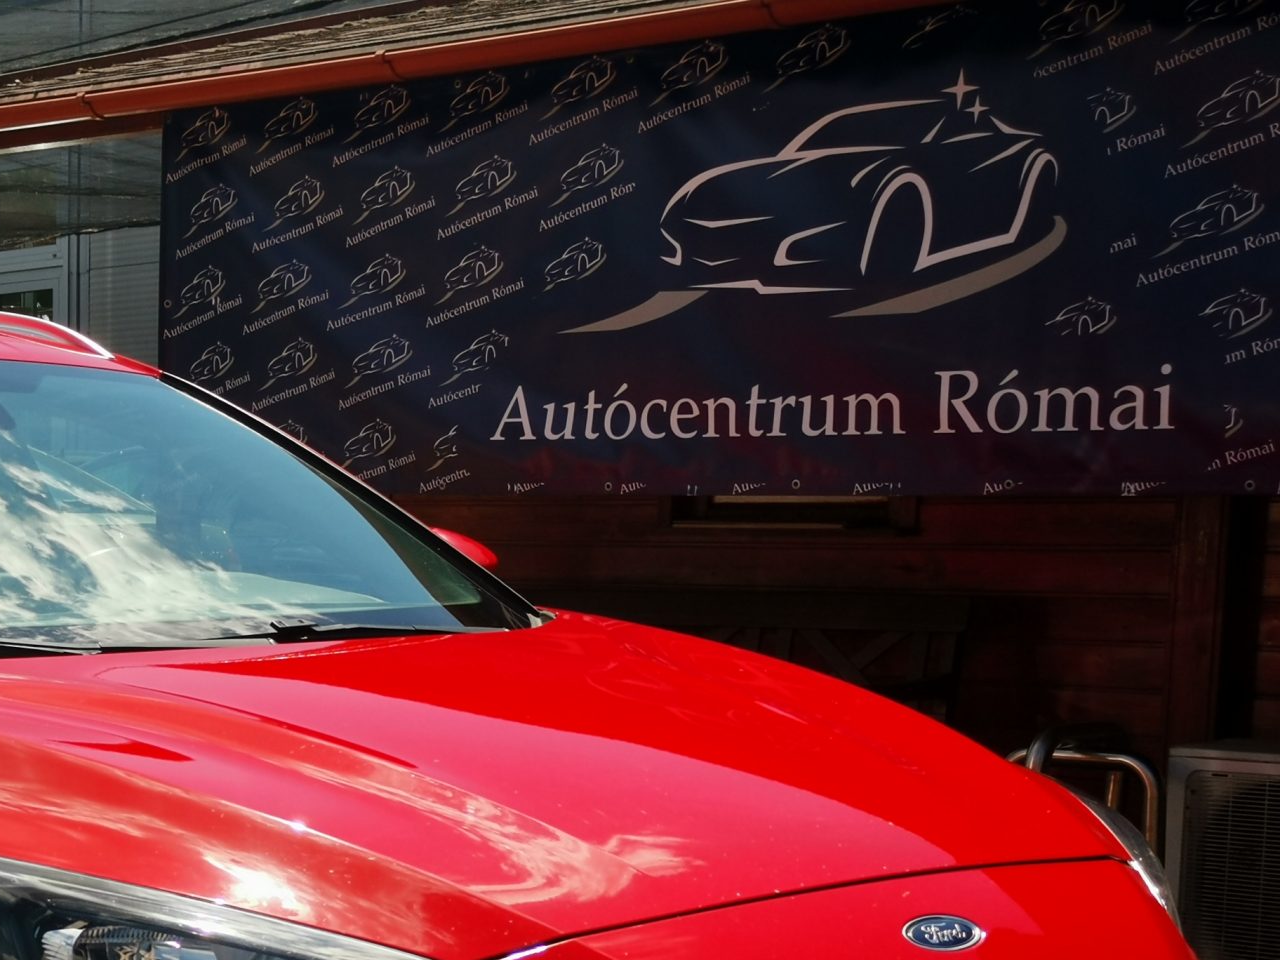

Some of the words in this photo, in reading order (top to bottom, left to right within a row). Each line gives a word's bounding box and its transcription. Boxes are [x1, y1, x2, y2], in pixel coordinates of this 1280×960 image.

[1107, 20, 1153, 50] Római
[1154, 25, 1252, 76] Autócentrum
[529, 107, 599, 145] Autócentrum
[603, 86, 639, 111] Római
[638, 93, 711, 134] Autócentrum
[714, 72, 751, 99] Római
[249, 142, 302, 177] Autócentrum
[305, 125, 335, 147] Római
[332, 133, 394, 168] Autócentrum
[397, 113, 429, 137] Római
[426, 119, 492, 157] Autócentrum
[495, 101, 529, 124] Római
[1116, 122, 1166, 153] Római
[165, 152, 220, 184] Autócentrum
[222, 134, 247, 157] Római
[1164, 131, 1265, 179] Autócentrum
[176, 229, 223, 260] Autócentrum
[225, 212, 255, 233] Római
[251, 221, 314, 254] Autócentrum
[316, 204, 343, 227] Római
[346, 214, 402, 248] Autócentrum
[405, 195, 436, 219] Római
[437, 203, 502, 240] Autócentrum
[504, 186, 538, 209] Római
[539, 195, 608, 232] Autócentrum
[1136, 245, 1238, 287] Autócentrum
[162, 309, 215, 339] Autócentrum
[217, 293, 243, 313] Római
[243, 306, 295, 335] Autócentrum
[298, 289, 329, 310] Római
[326, 300, 392, 331] Autócentrum
[395, 284, 426, 305] Római
[425, 293, 489, 328] Autócentrum
[492, 276, 524, 298] Római
[226, 371, 251, 391] Római
[251, 384, 308, 412] Autócentrum
[309, 368, 336, 390] Római
[339, 381, 394, 411] Autócentrum
[397, 365, 431, 386] Római
[489, 383, 906, 441] Autócentrum
[933, 363, 1176, 434] Római
[388, 450, 416, 471] Római
[1225, 440, 1276, 465] Római
[921, 922, 966, 944] Ford
